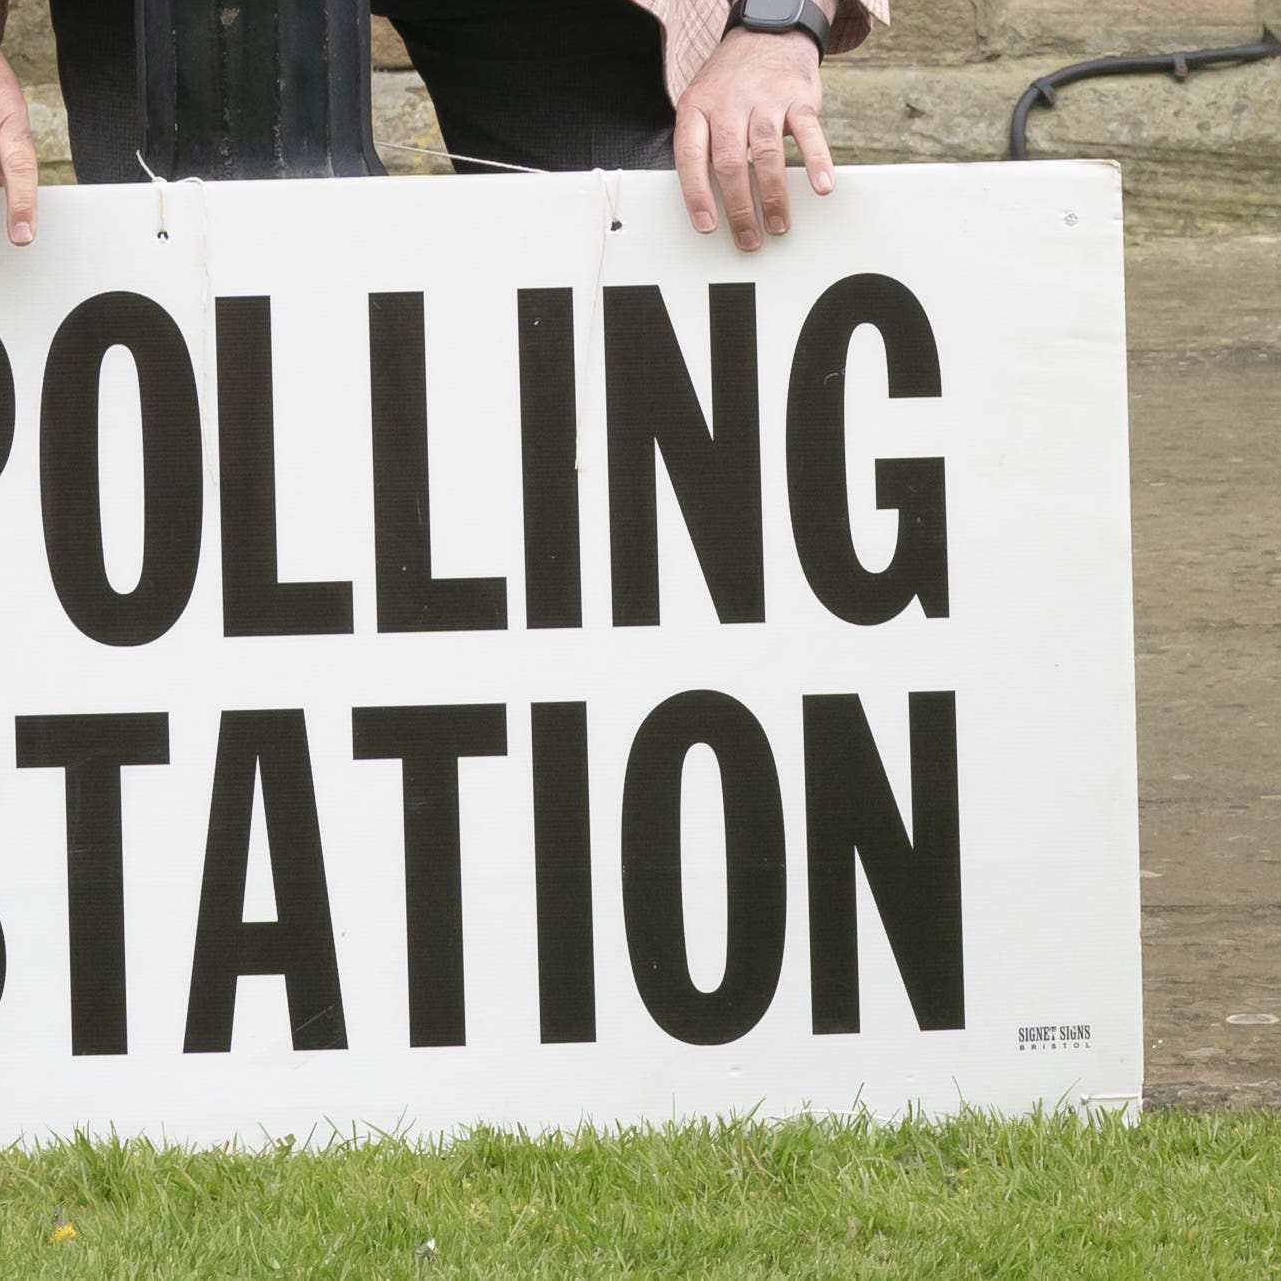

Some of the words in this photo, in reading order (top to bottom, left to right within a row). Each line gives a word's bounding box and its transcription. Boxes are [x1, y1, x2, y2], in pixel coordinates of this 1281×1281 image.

[1018, 1026, 1057, 1042] SIGNET
[1059, 1025, 1091, 1040] SIGNS
[1019, 1042, 1091, 1051] BRISTOL
